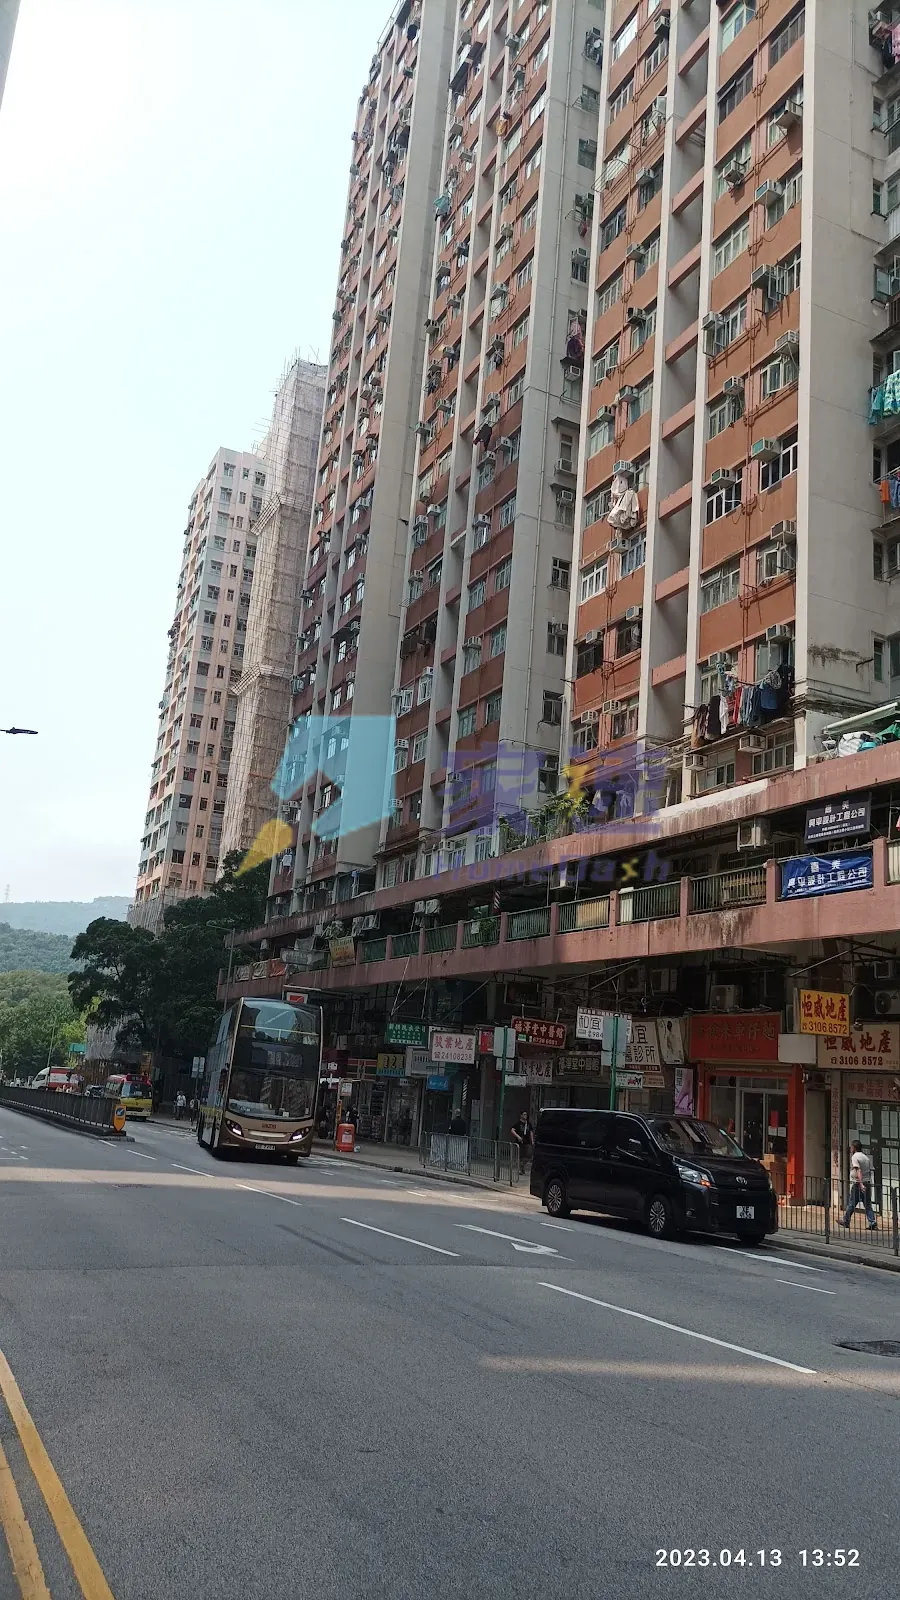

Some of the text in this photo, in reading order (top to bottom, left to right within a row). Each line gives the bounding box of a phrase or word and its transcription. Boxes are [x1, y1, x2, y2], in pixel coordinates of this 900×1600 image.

[802, 993, 847, 1021] 恒威地產
[808, 1021, 847, 1034] 3106 8572
[839, 1056, 859, 1066] 3106
[861, 1056, 884, 1066] 8572
